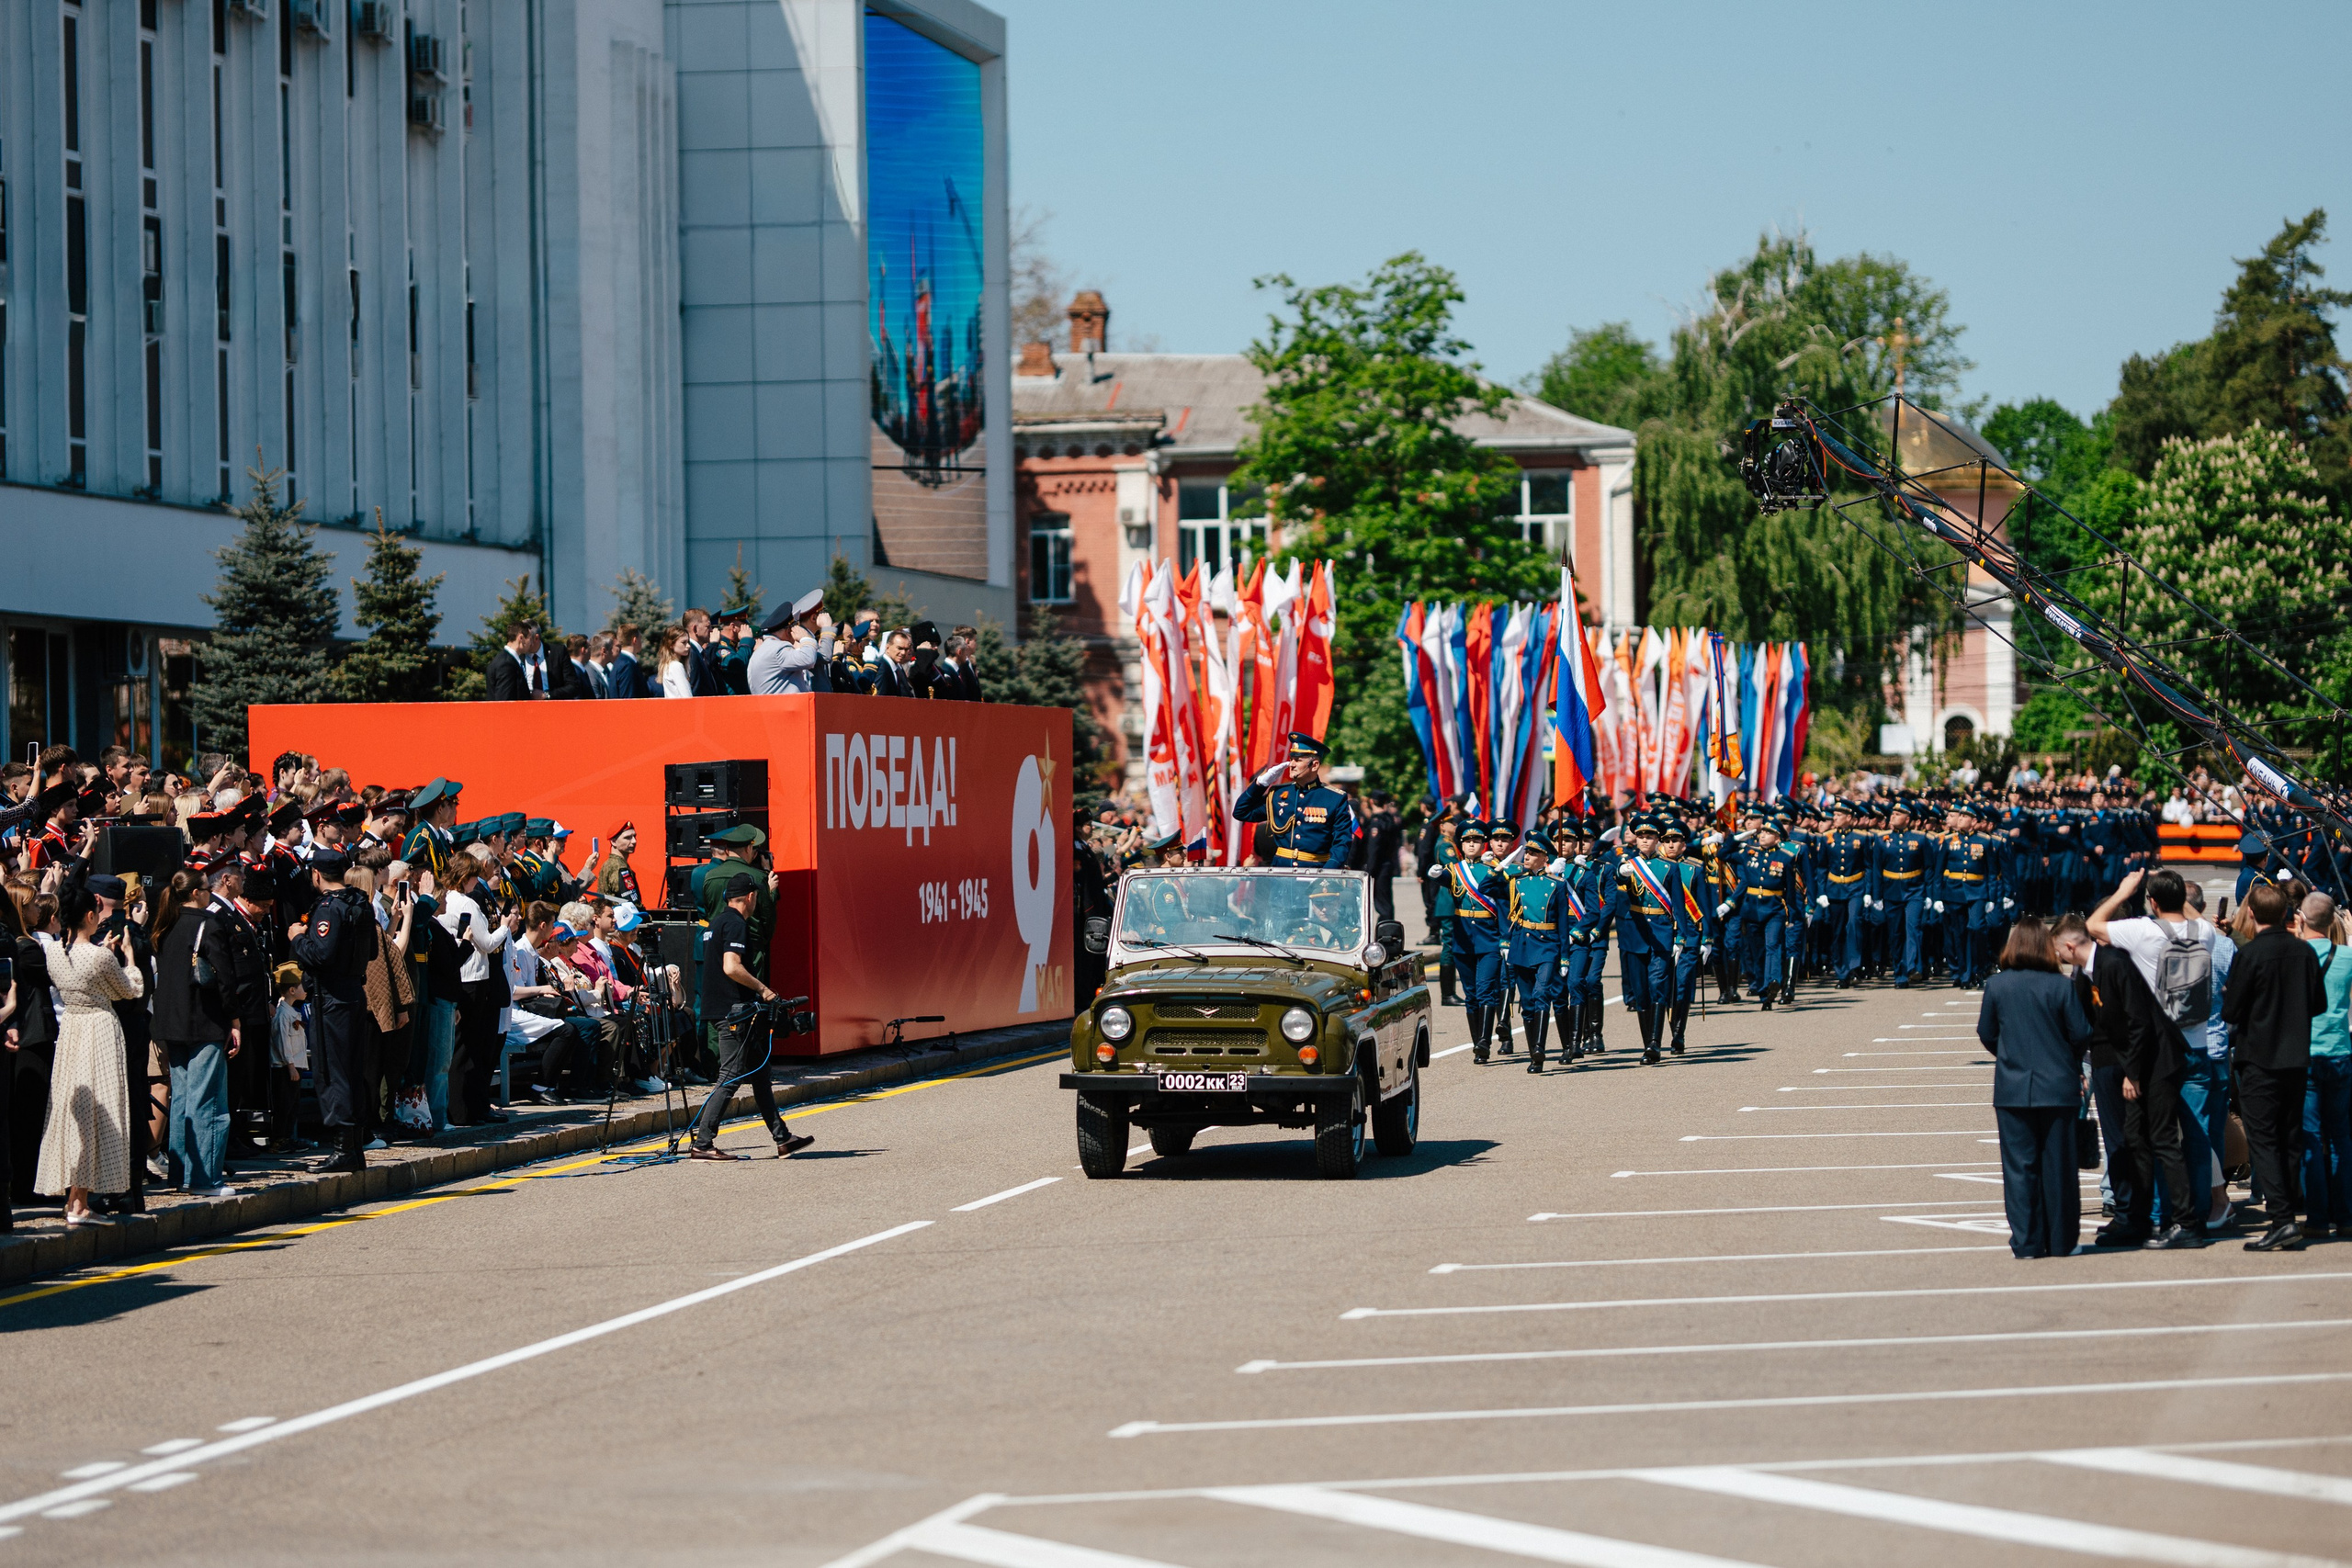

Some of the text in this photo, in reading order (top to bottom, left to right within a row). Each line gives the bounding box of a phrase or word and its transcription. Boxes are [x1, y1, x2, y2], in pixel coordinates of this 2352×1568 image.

[826, 732, 956, 847] ПОБЕДА!
[1154, 768, 1177, 787] МА
[1012, 754, 1055, 1013] 9
[1035, 964, 1064, 1010] МАЯ
[1229, 1074, 1245, 1086] 23
